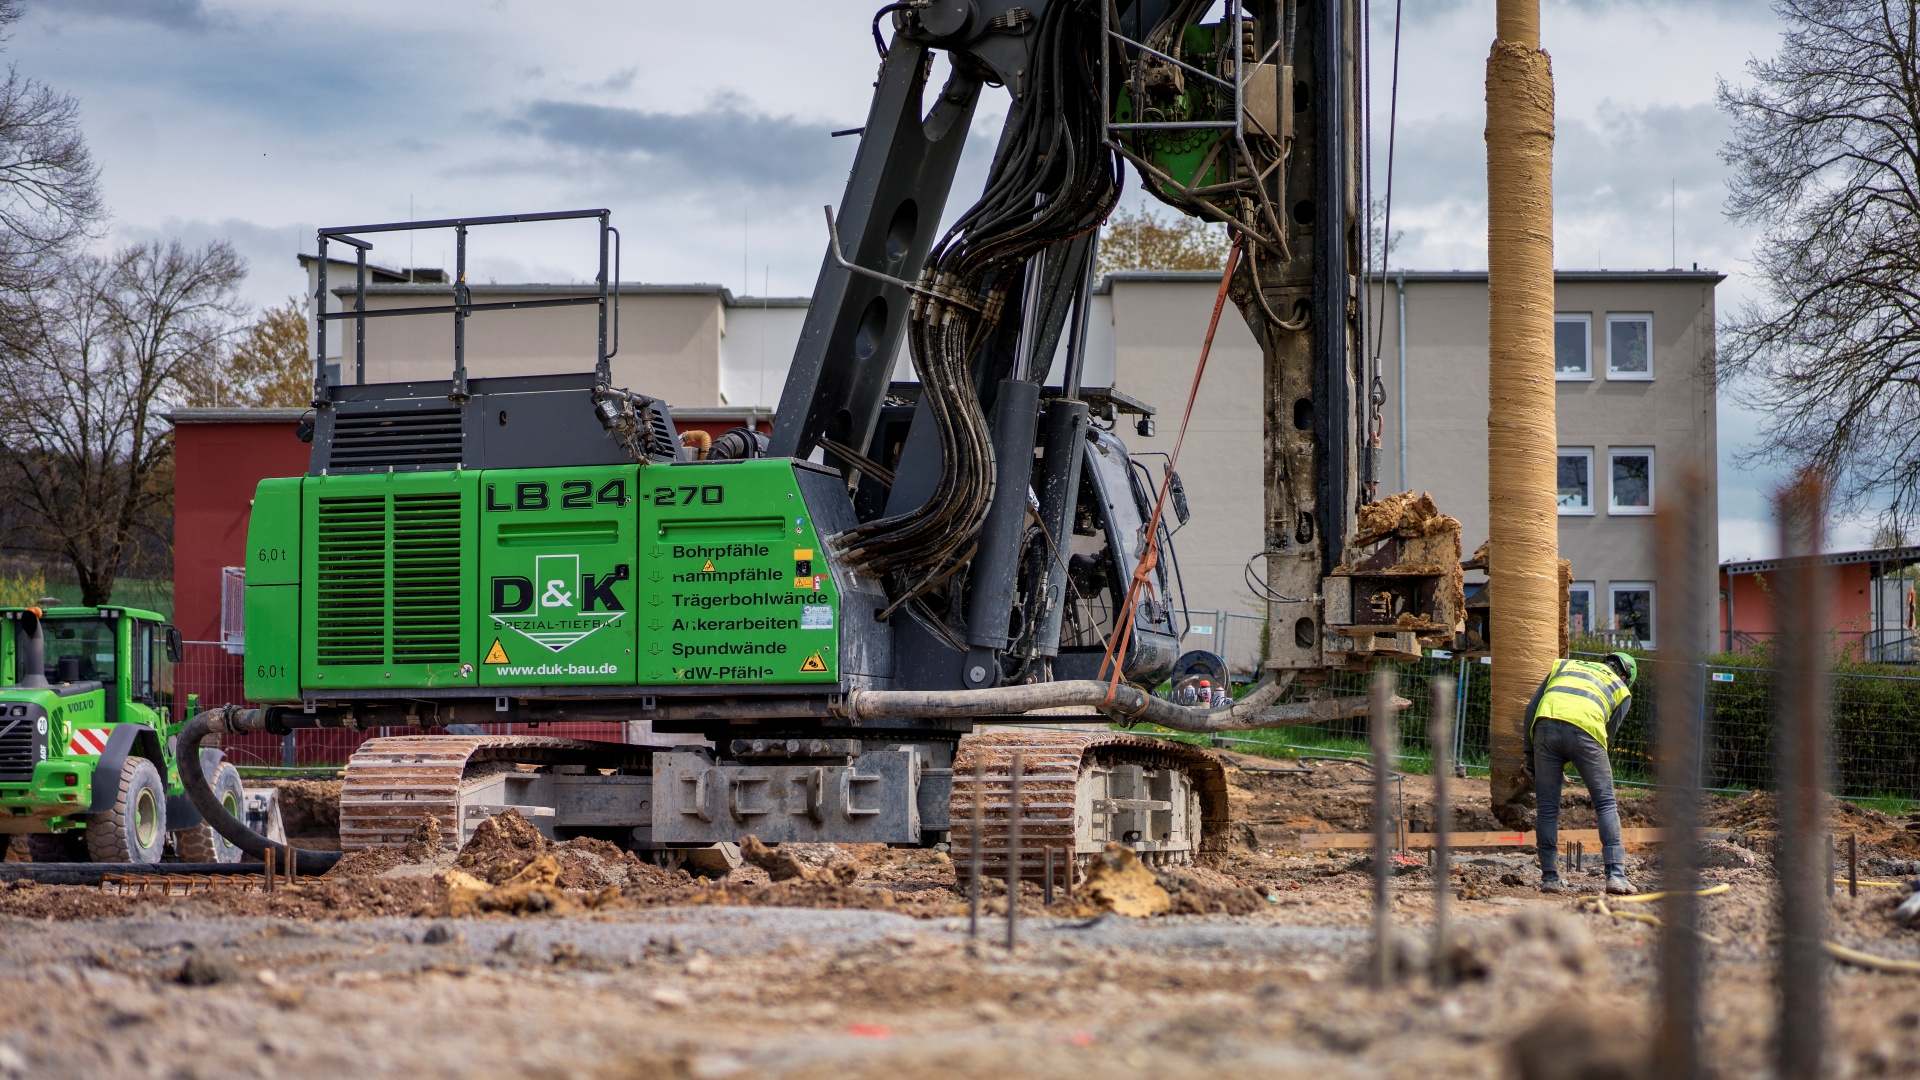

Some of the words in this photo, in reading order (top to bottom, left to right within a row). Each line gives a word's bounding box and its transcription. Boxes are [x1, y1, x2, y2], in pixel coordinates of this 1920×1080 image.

[486, 481, 550, 512] LB
[259, 548, 278, 562] 6,0
[281, 549, 286, 560] t
[673, 544, 769, 560] Bohrpfähle
[672, 592, 828, 609] Trägerbohlwände
[672, 641, 787, 658] Spundwände
[258, 665, 277, 679] 6,0
[280, 666, 285, 677] t
[497, 663, 617, 675] www.duk-bau.de
[67, 699, 94, 713] VOLVO
[39, 719, 46, 732] 20
